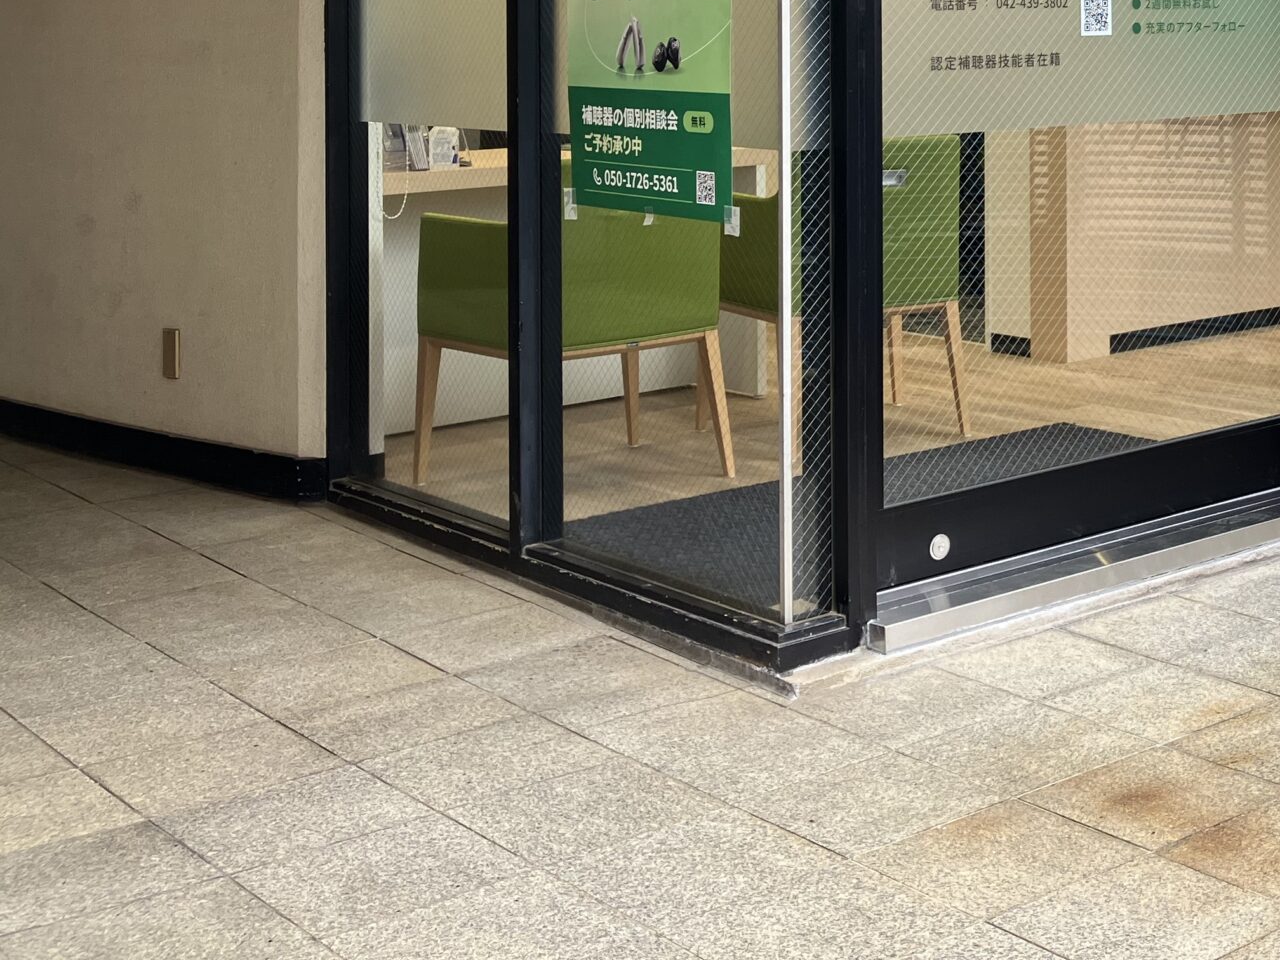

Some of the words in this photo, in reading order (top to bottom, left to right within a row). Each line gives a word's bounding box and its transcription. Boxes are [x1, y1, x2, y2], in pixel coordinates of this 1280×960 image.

[930, 52, 1061, 71] 認定補聴器技能者在籍
[582, 105, 678, 131] 補聴器の個別相談会
[584, 133, 642, 156] ご予約承り中
[604, 169, 679, 193] 050-1726-5361
